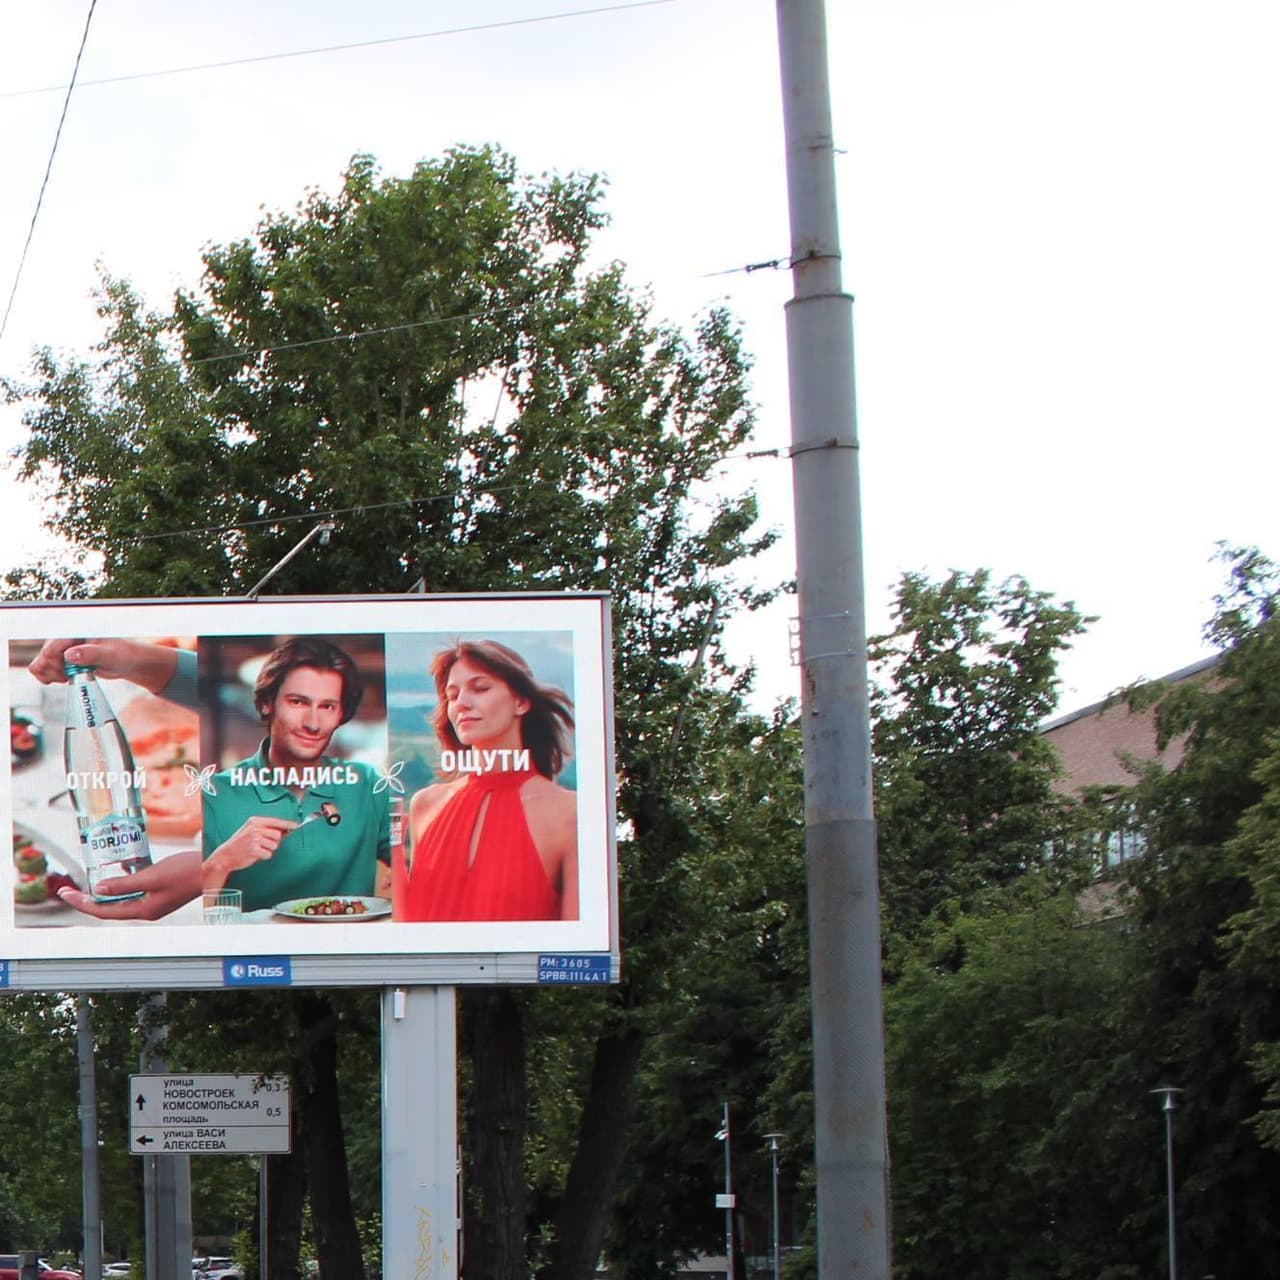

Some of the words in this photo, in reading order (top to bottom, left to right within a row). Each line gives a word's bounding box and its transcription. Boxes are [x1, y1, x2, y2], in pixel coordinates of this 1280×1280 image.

[66, 766, 147, 790] ОТКРОЙ
[229, 766, 359, 789] НАСЛАДИСЬ
[440, 749, 530, 776] ОЩУТИ
[561, 958, 591, 968] 3605
[247, 964, 284, 978] Russ
[163, 1079, 194, 1088] улица
[164, 1088, 236, 1098] НОВОСТРОЕК
[162, 1100, 259, 1110] КОМСОМОЛЬСКАЯ
[266, 1107, 281, 1117] 0,5
[163, 1115, 209, 1125] площадь
[163, 1130, 194, 1139] улица
[197, 1128, 226, 1138] ВАСИ
[163, 1140, 226, 1150] АЛЕКСЕЕВА
